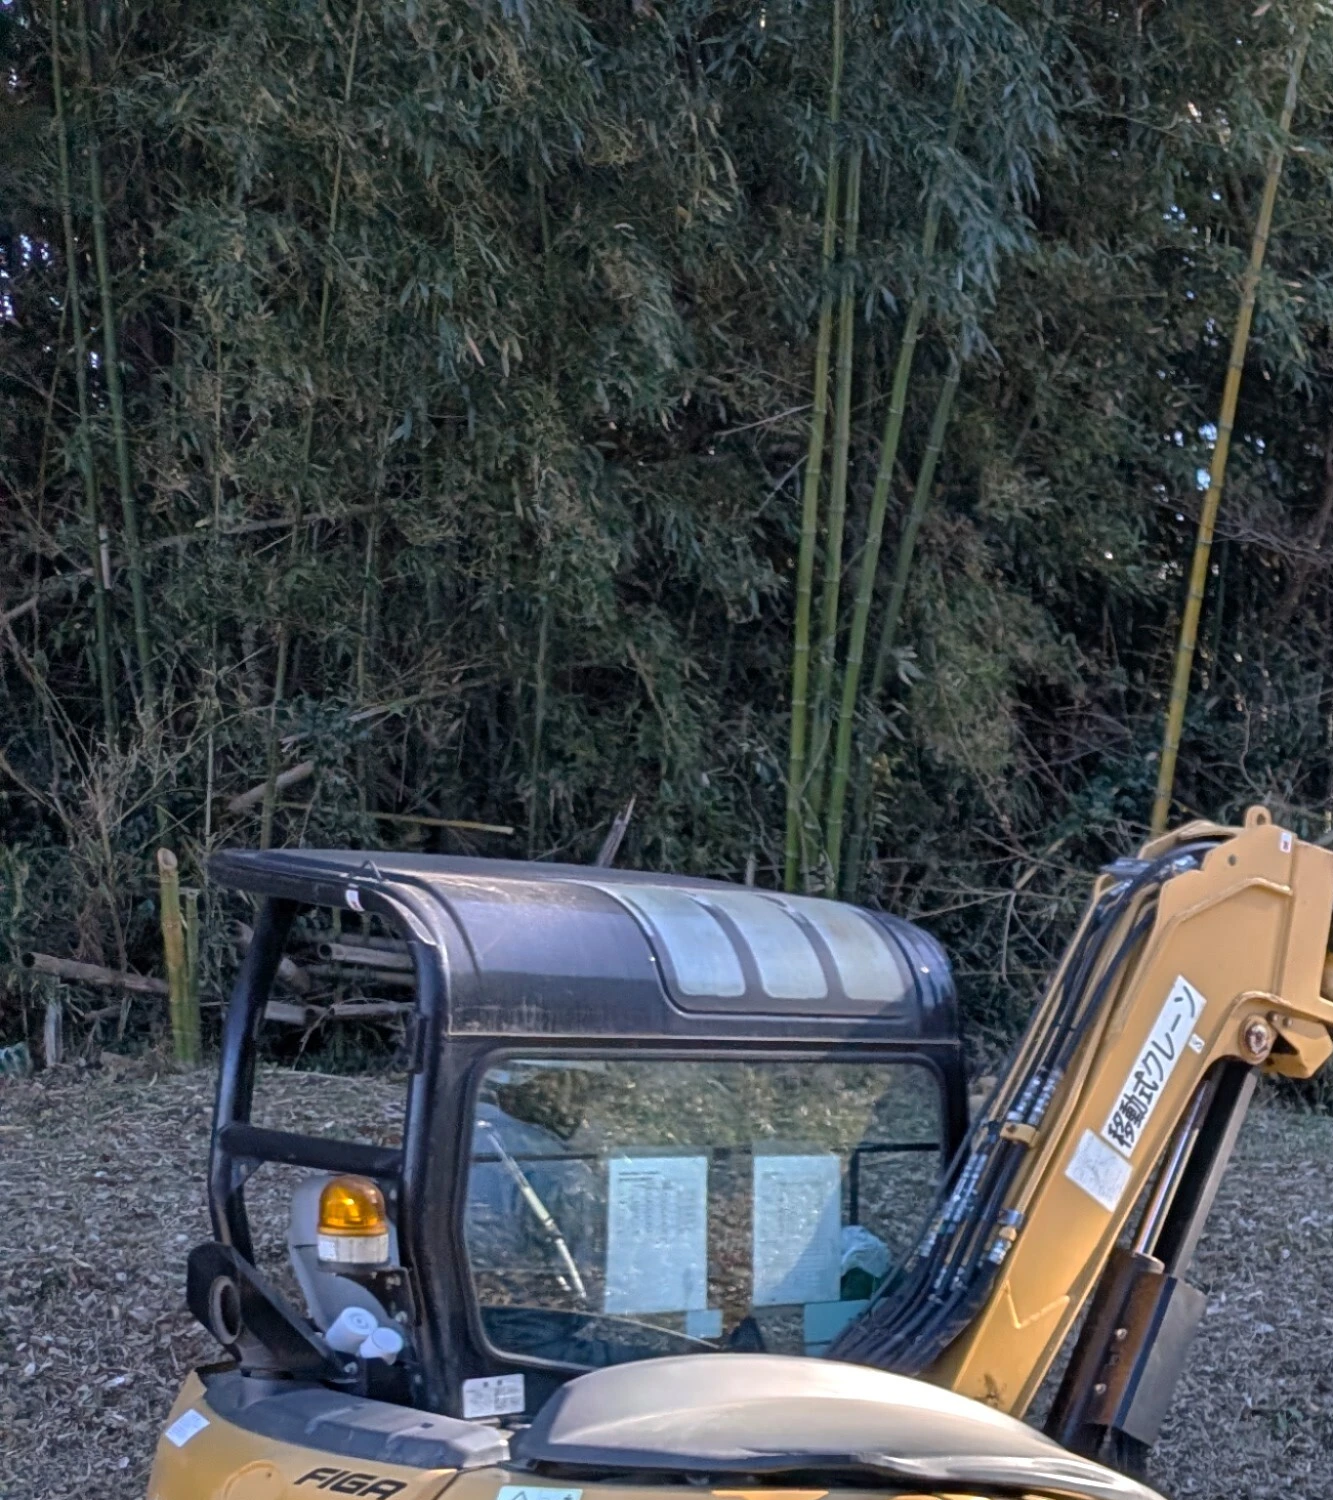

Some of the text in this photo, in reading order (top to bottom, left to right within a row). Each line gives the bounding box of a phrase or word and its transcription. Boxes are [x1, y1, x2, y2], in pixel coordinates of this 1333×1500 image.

[1107, 985, 1196, 1149] 移動式クレーン
[293, 1467, 408, 1500] FIGA
